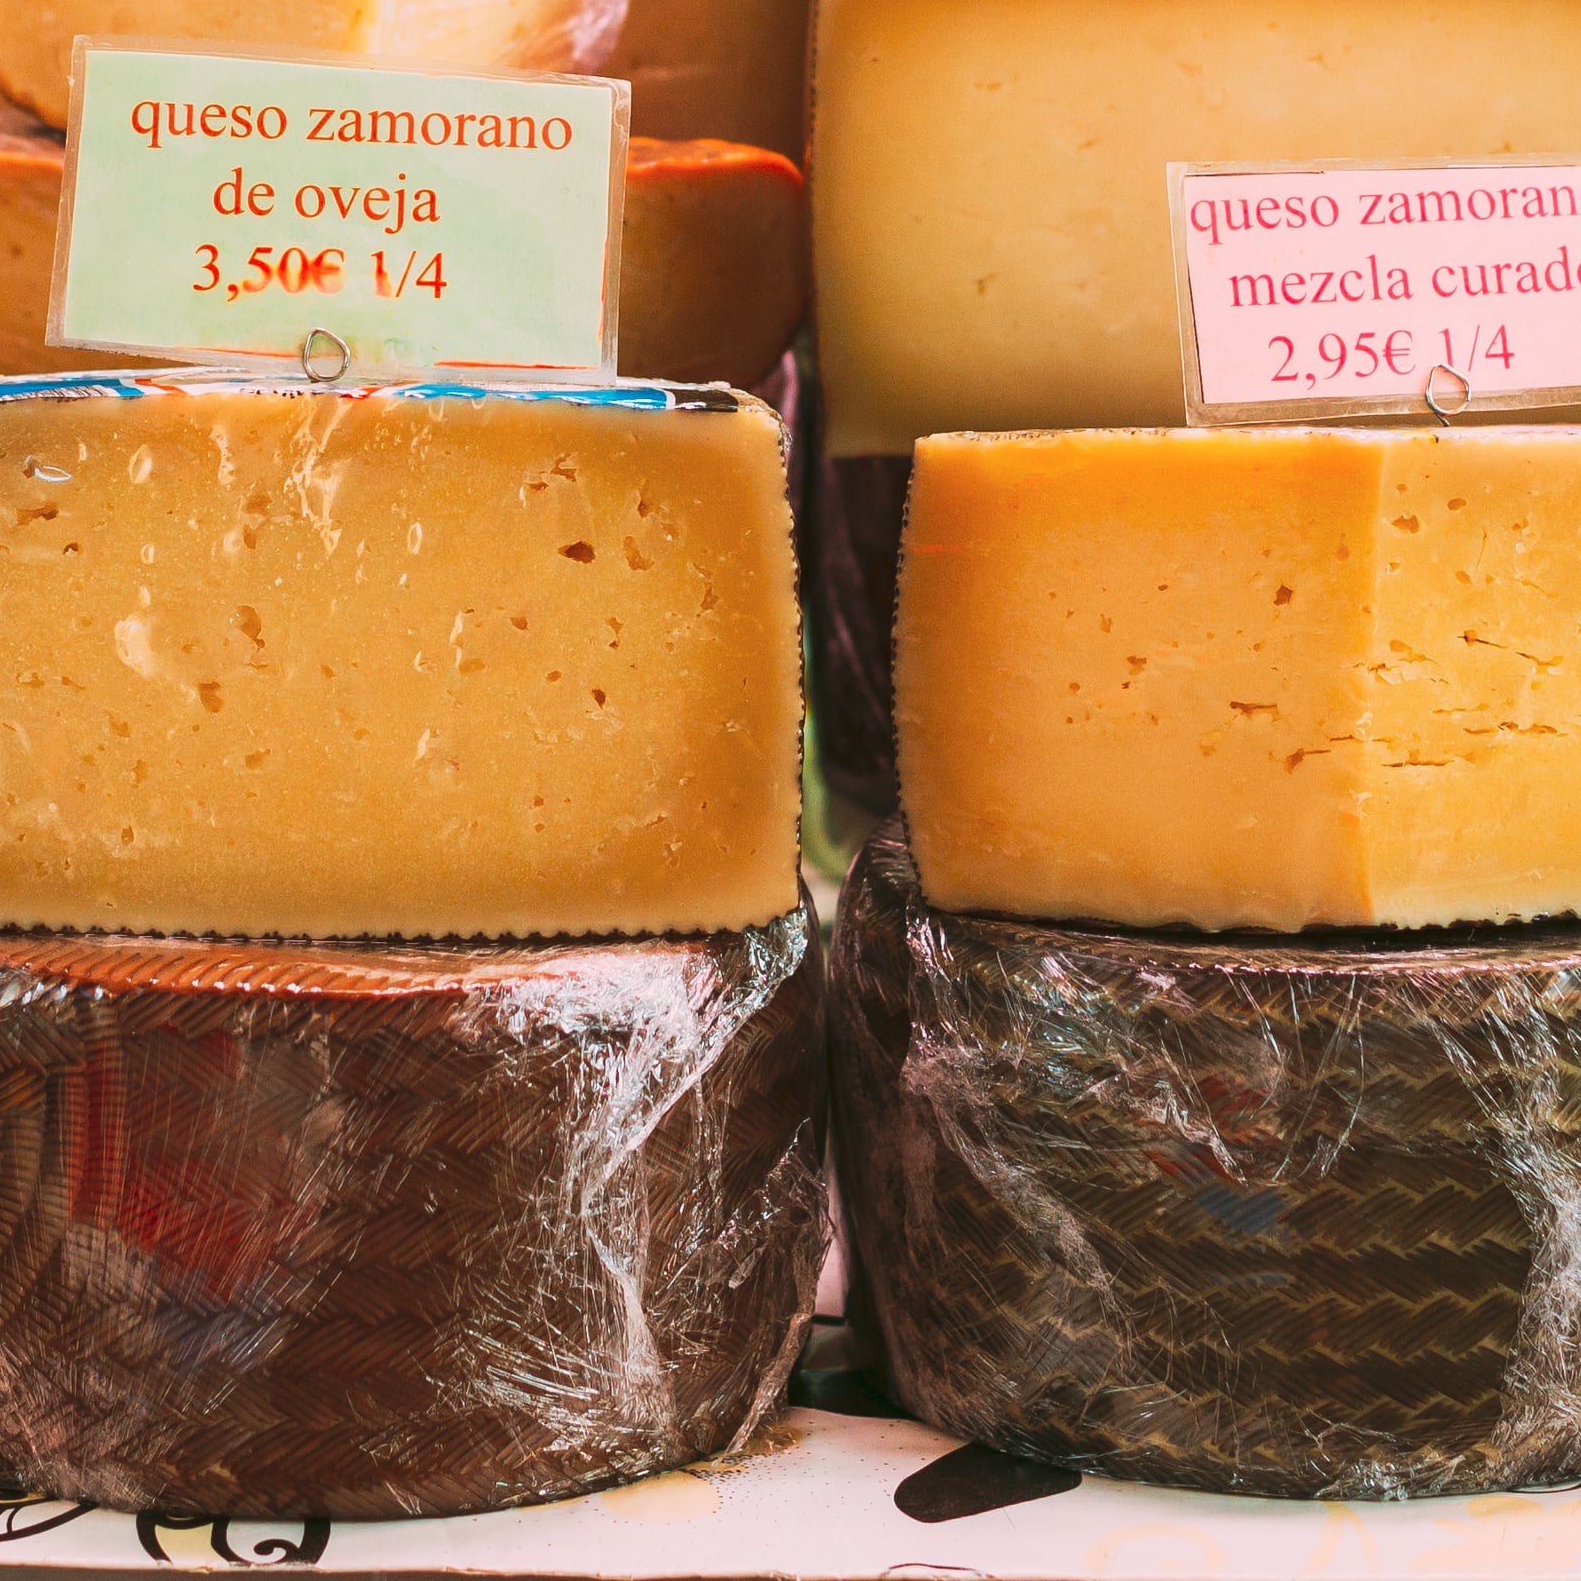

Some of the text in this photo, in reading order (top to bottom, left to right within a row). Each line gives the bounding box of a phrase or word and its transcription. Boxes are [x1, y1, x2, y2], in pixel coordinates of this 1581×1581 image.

[130, 98, 574, 152] queso zamorano
[212, 166, 441, 235] de oveja
[1189, 191, 1340, 247] queso
[192, 242, 448, 303] 3,50€ 1/4
[1229, 253, 1415, 308] mezcla
[1267, 323, 1516, 390] 2,95€ 1/4
